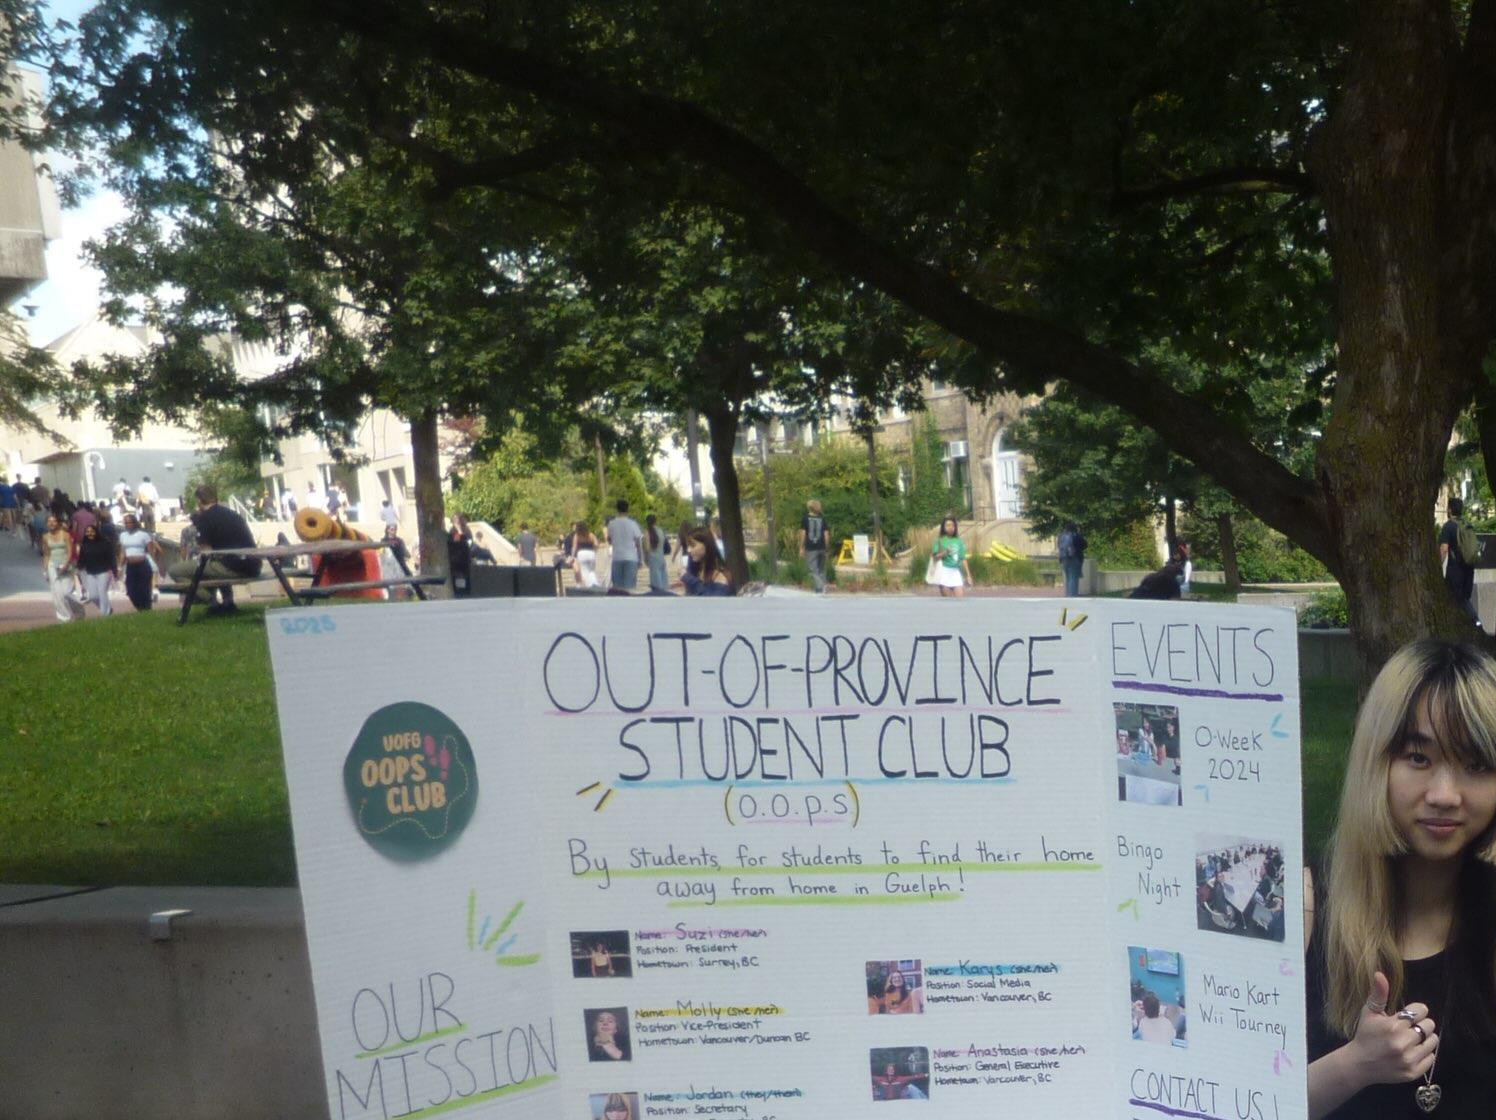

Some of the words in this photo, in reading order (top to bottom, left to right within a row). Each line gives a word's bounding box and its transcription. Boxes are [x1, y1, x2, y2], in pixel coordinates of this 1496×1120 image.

[1111, 621, 1275, 687] EVENTS
[543, 632, 1061, 713] OUT-OF-PROVINCE
[383, 731, 421, 752] UOFG
[619, 714, 860, 781] STUDENT
[878, 714, 1012, 779] CLUB
[361, 753, 427, 787] OOPS
[1208, 759, 1261, 782] 2024
[386, 782, 447, 815] CLUB
[568, 838, 611, 889] By
[736, 845, 767, 868] for
[880, 843, 900, 866] to
[917, 842, 962, 865] find
[976, 841, 1022, 863] their
[1042, 836, 1096, 863] home
[1117, 835, 1163, 870] Bingo
[657, 876, 716, 904] away
[731, 876, 776, 897] from
[788, 873, 838, 896] home
[854, 878, 870, 895] in
[885, 867, 966, 899] Guelph!
[1138, 873, 1181, 905] Night
[675, 922, 713, 940] Suzi
[636, 945, 678, 955] Position:
[685, 943, 738, 954] President
[742, 956, 760, 967] BC
[959, 959, 1005, 982] Karys
[967, 979, 996, 989] Social
[1000, 978, 1031, 988] Media
[1202, 974, 1241, 1000] Mario
[1247, 981, 1280, 1006] Kart
[1038, 991, 1053, 1002] BC
[352, 972, 463, 1052] OUR
[676, 1000, 721, 1020] Molly
[795, 1030, 811, 1042] BC
[1200, 1002, 1224, 1026] Wii
[1230, 1008, 1287, 1051] Tourney
[969, 1043, 1029, 1059] Anastasia
[975, 1060, 1011, 1071] General
[1015, 1060, 1061, 1070] Executive
[1038, 1072, 1053, 1083] BC
[687, 1084, 734, 1101] Jordan
[1130, 1068, 1219, 1114] CONTACT
[694, 1103, 748, 1118] Secretary
